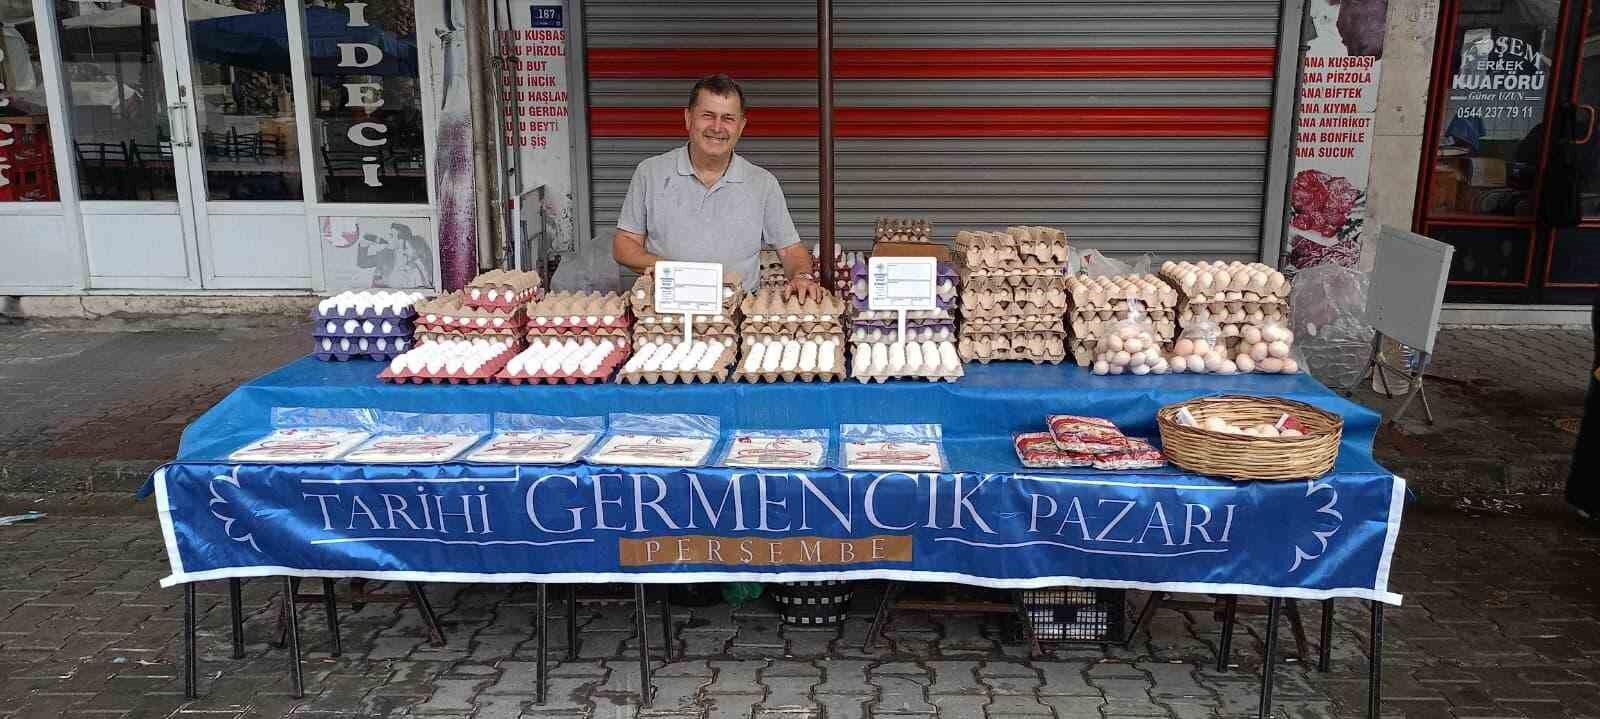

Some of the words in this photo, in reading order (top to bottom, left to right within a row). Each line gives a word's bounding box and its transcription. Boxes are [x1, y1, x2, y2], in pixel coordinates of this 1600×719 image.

[538, 8, 555, 19] 187
[525, 30, 566, 44] KUŞBAŞ
[527, 61, 547, 71] BUT
[1477, 60, 1524, 71] ERKEK
[1326, 70, 1371, 83] PİRZOLA
[1452, 71, 1545, 90] KUAFÖRÜ
[1325, 85, 1362, 98] BİFTEK
[1323, 103, 1357, 113] KIYMA
[1457, 106, 1482, 118] 0544
[1485, 106, 1504, 119] 237
[1505, 106, 1519, 118] 79
[1521, 106, 1533, 118] 11
[1320, 129, 1365, 142] BONFİLE
[1318, 147, 1354, 158] SUCUK
[303, 485, 497, 536] TARİHİ
[1026, 493, 1237, 546] PAZARI
